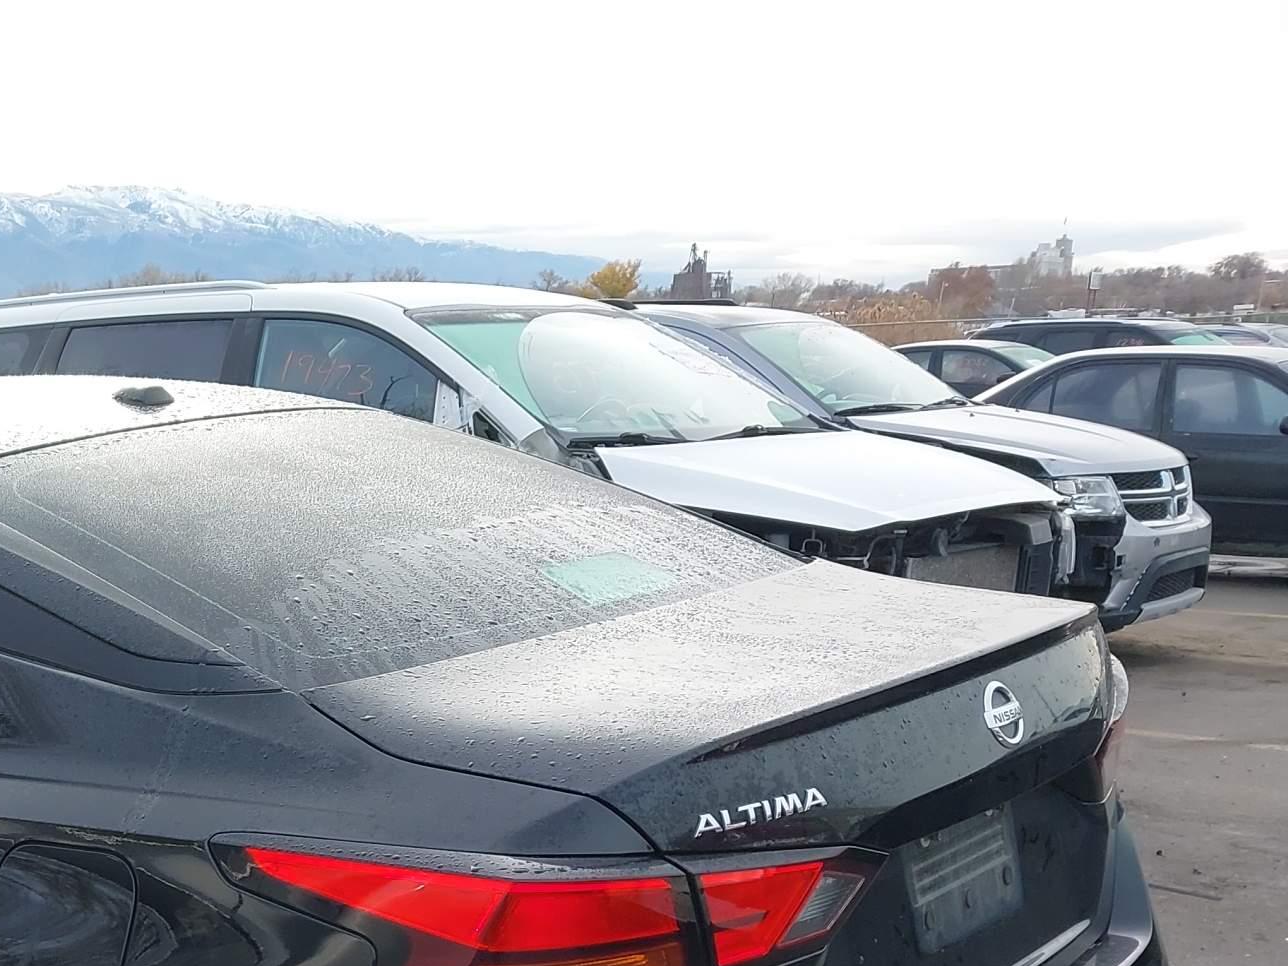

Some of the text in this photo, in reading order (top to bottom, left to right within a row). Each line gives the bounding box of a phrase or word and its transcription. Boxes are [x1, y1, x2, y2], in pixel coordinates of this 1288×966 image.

[280, 350, 374, 396] 19473
[993, 706, 1023, 724] NISSA
[694, 787, 828, 839] ALTIMA
